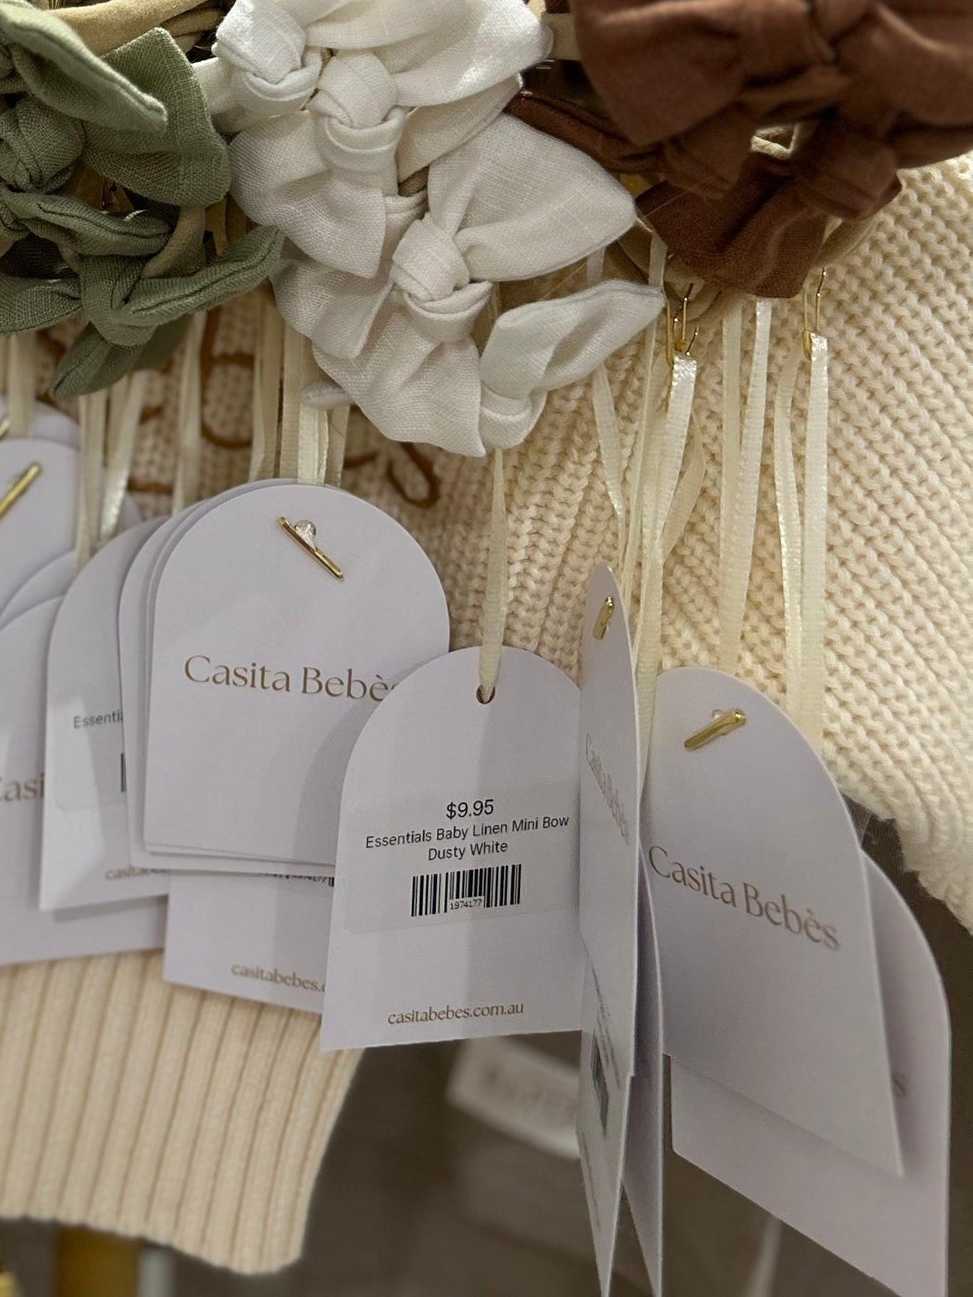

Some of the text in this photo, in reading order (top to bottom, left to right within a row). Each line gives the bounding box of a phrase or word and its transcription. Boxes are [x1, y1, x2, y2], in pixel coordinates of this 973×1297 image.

[184, 655, 398, 703] Casita Bebè
[446, 799, 495, 820] $9.95
[366, 816, 570, 849] Essentials Baby Linen Mini Bow
[428, 841, 509, 861] Dusty White
[449, 898, 483, 910] 1974177
[648, 845, 840, 951] Casita Bebès
[387, 1003, 524, 1025] casitabebes.com.au
